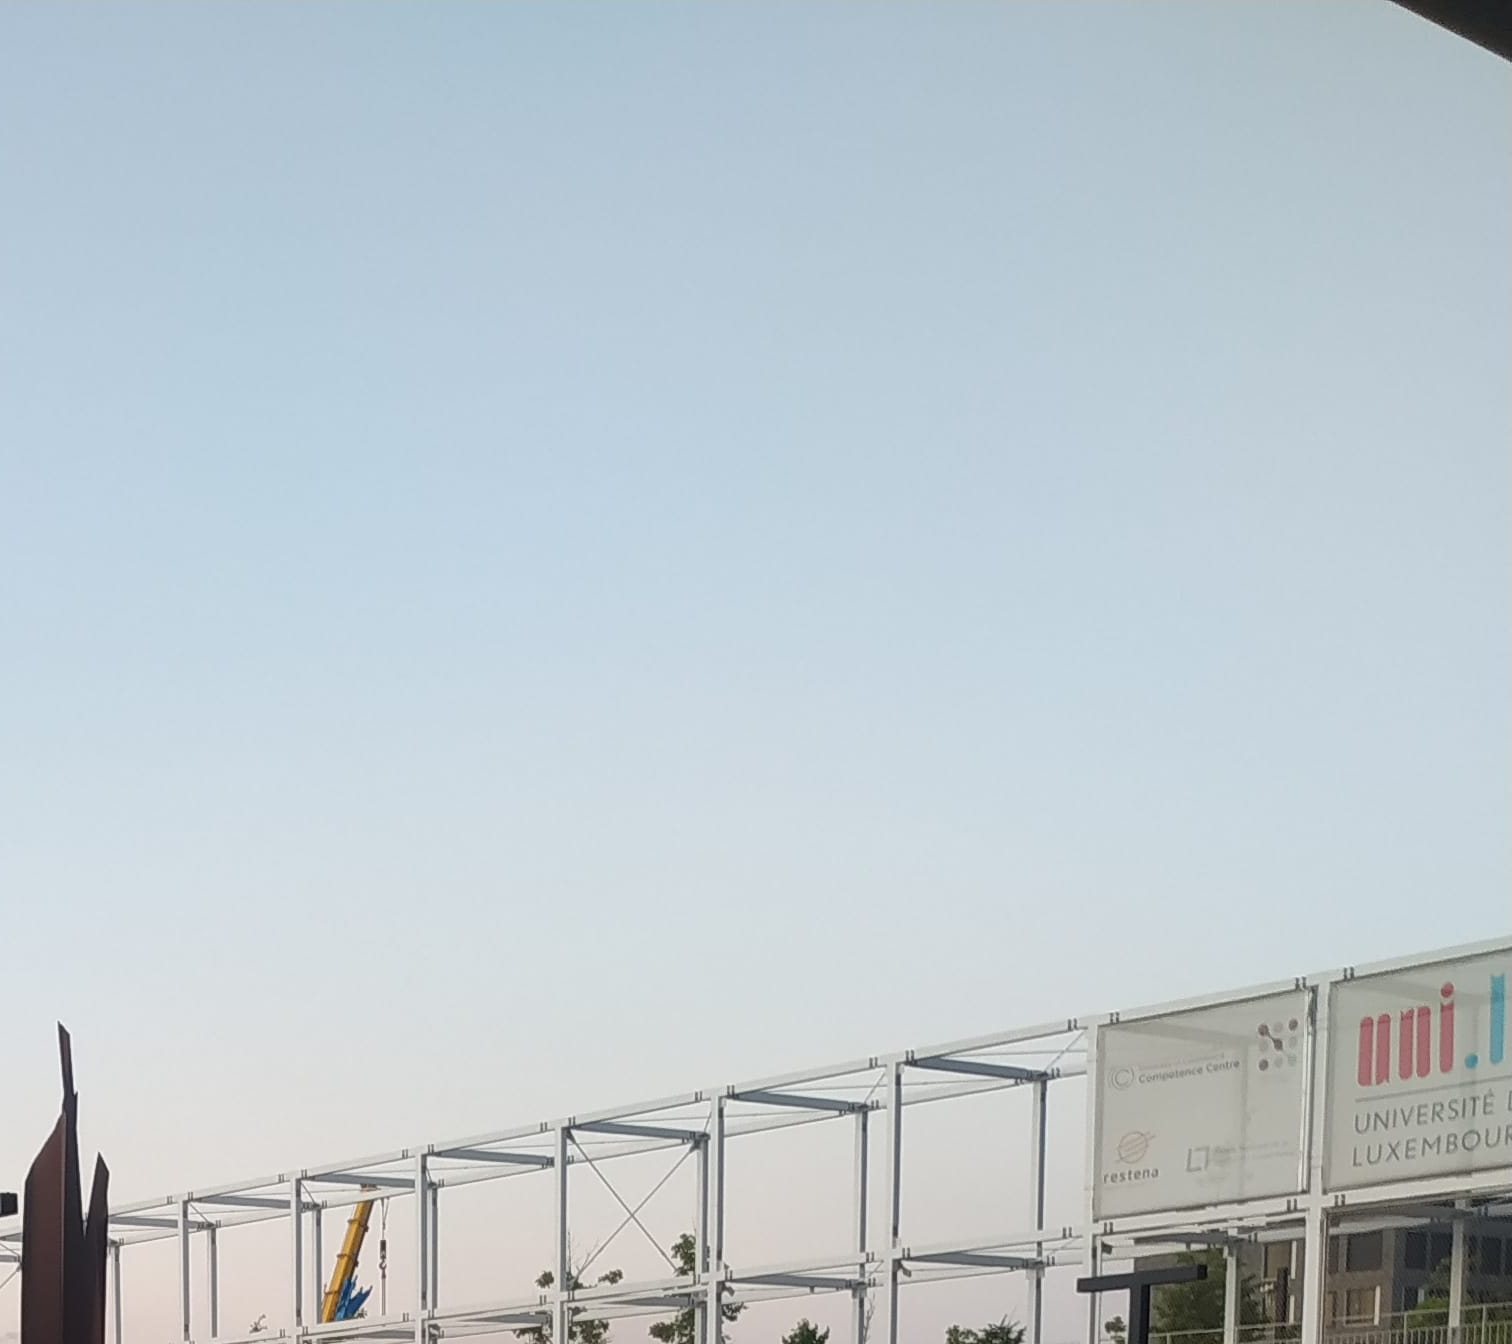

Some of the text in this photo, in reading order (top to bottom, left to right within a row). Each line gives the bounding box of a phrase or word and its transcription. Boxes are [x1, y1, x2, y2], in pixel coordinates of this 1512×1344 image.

[1139, 1066, 1203, 1084] Competence
[1206, 1060, 1241, 1073] Centre
[1354, 1088, 1495, 1135] UNIVERSITÉ
[1103, 1167, 1159, 1184] restena
